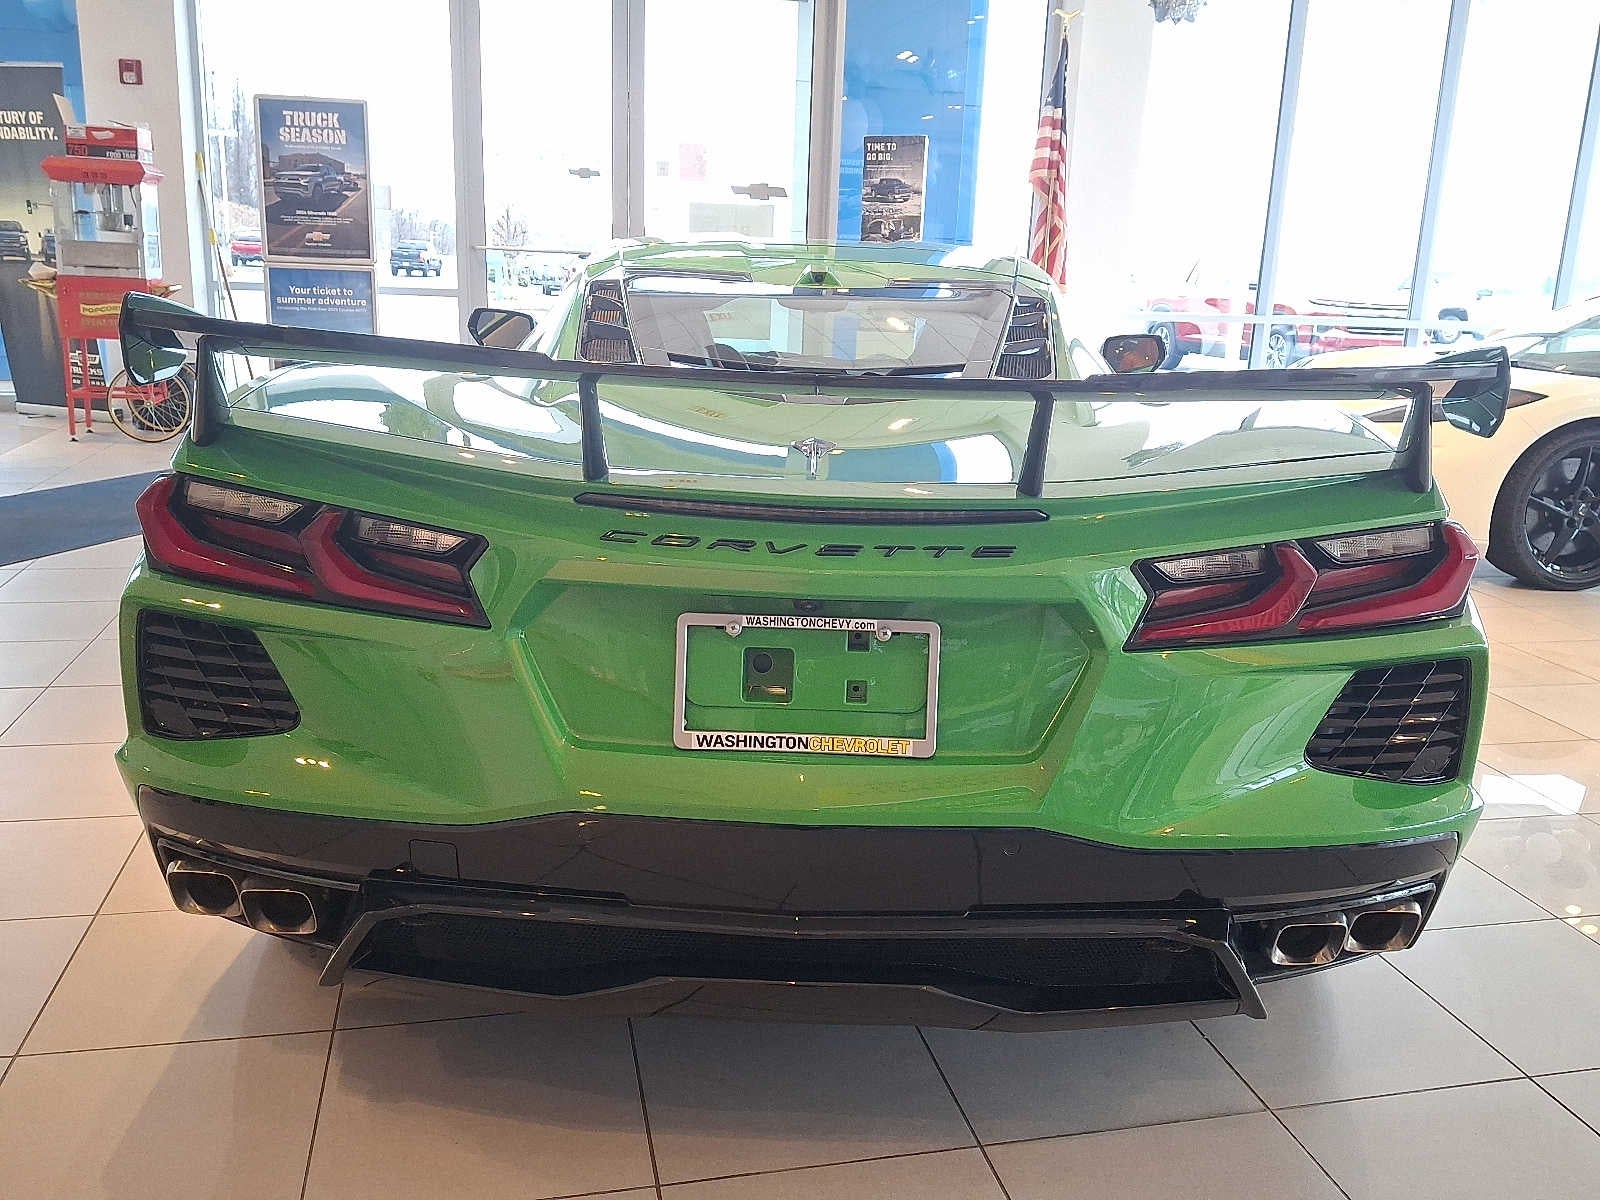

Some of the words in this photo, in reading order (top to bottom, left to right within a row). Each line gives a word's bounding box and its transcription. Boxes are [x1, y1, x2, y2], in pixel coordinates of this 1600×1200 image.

[28, 111, 44, 124] OF
[282, 110, 340, 128] TRUCK
[279, 126, 347, 144] SEASON
[866, 143, 885, 151] TIME
[886, 143, 897, 151] TO
[288, 285, 312, 295] Your
[312, 286, 341, 296] ticket
[343, 288, 354, 296] to
[276, 296, 316, 305] summer
[317, 297, 367, 306] adventure
[599, 529, 1018, 559] CORVETTE
[745, 616, 876, 630] WASHINGTONCHEVY.com
